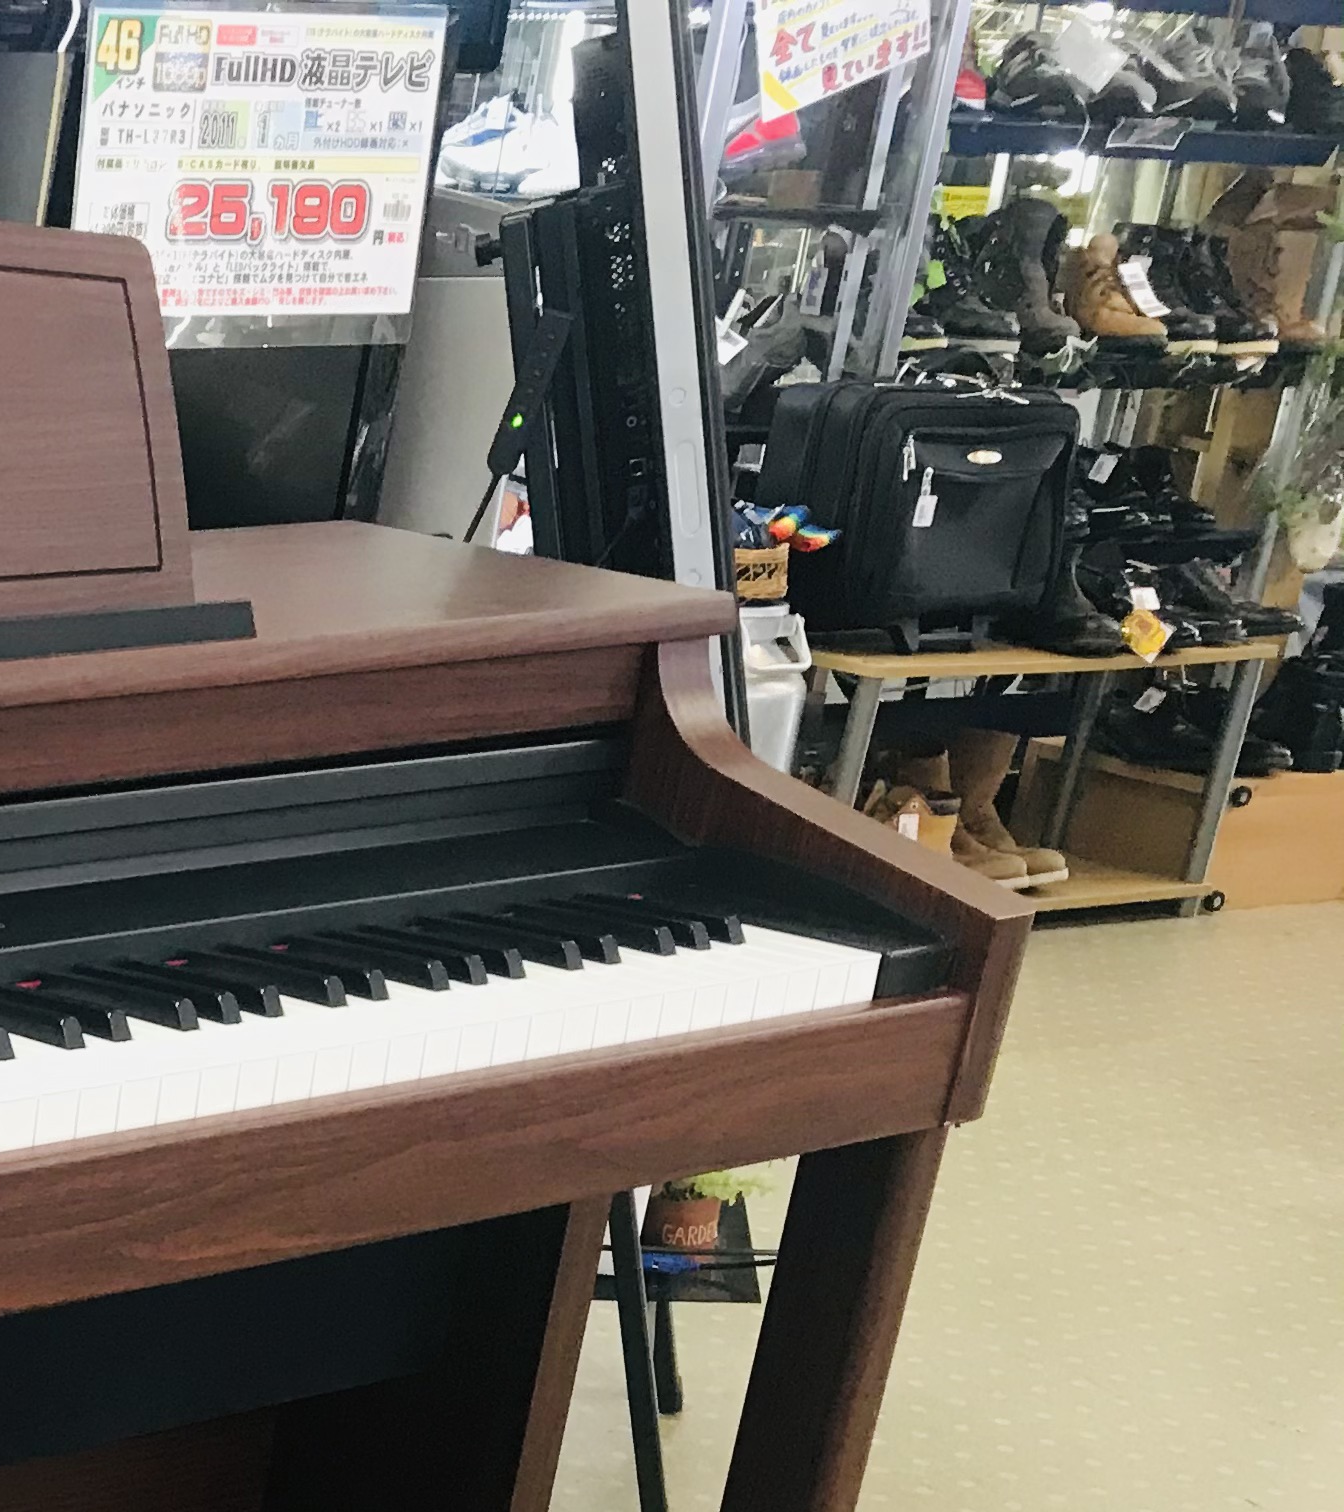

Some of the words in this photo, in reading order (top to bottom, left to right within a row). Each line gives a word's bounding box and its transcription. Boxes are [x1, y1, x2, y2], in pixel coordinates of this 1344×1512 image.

[96, 18, 144, 75] 46
[101, 101, 193, 120] パナソニック
[166, 178, 373, 246] 25,190
